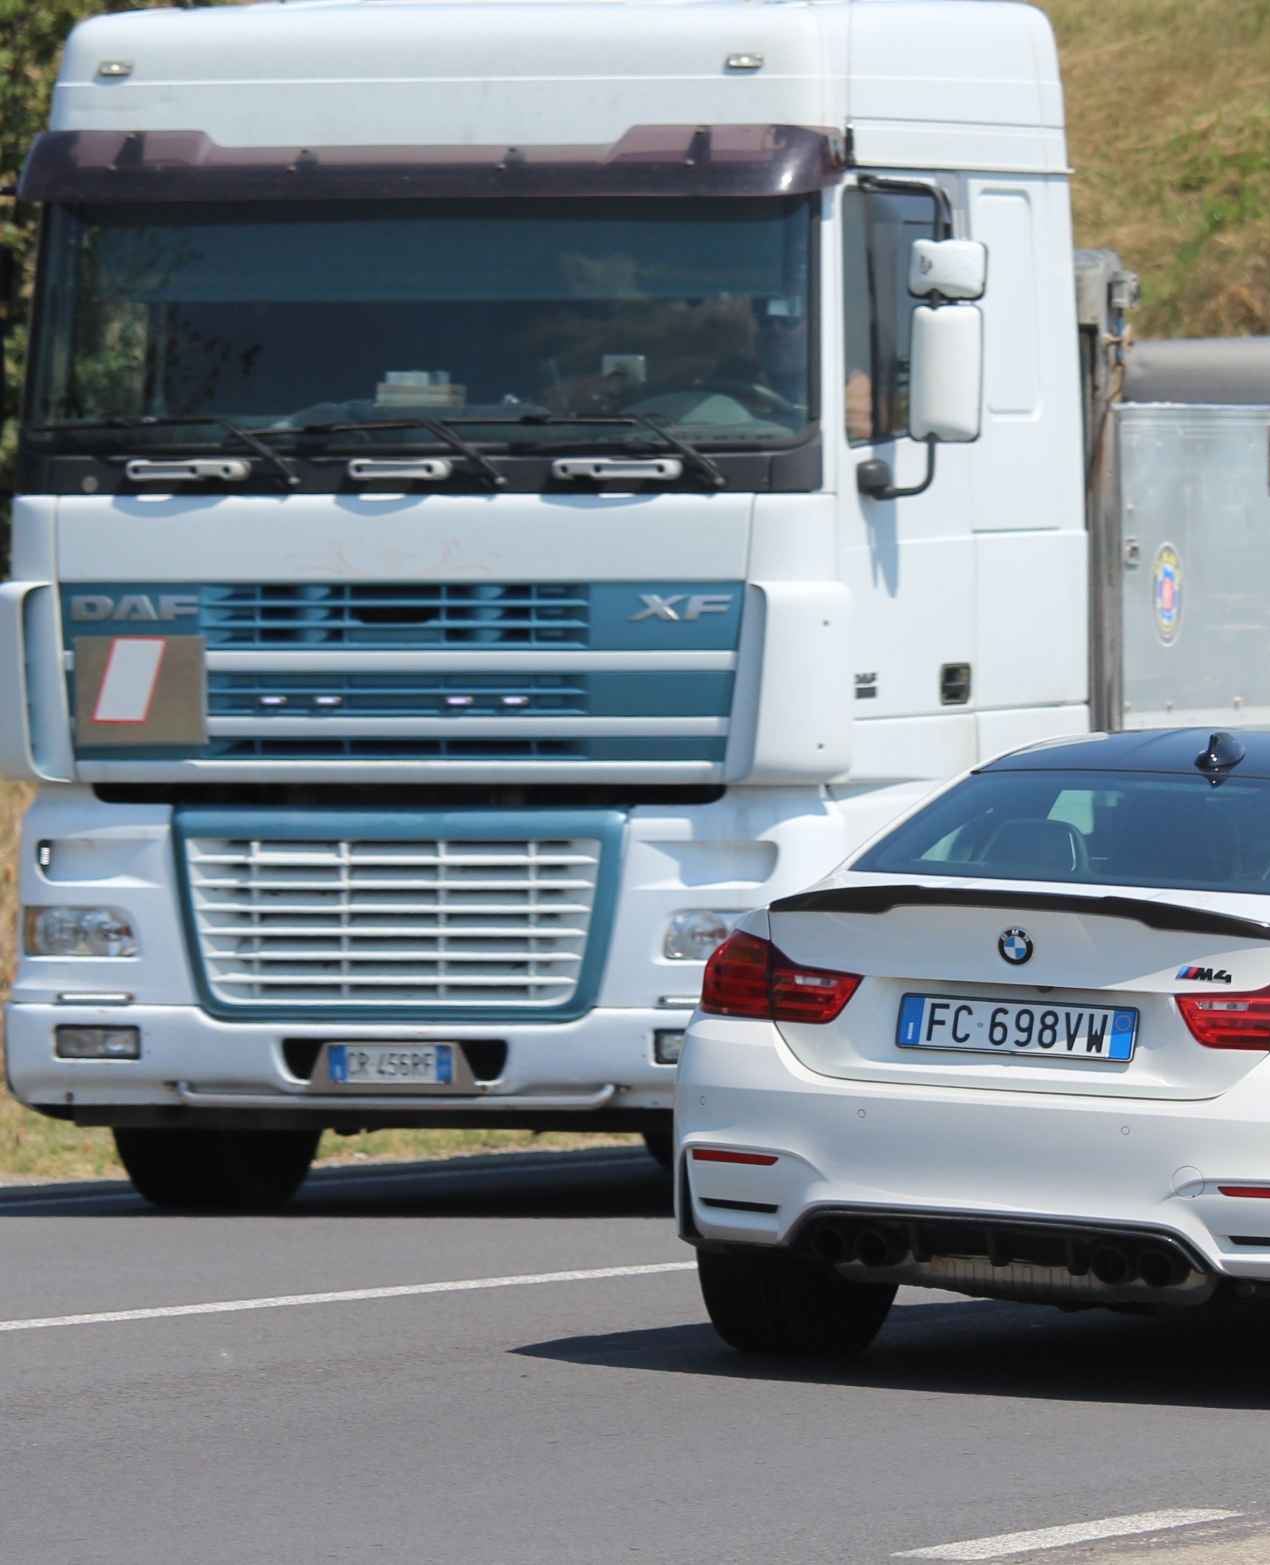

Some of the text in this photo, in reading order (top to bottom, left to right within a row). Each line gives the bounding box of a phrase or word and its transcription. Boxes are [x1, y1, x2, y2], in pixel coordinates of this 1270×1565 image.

[71, 594, 198, 621] DAF
[629, 593, 734, 621] XF
[1193, 966, 1232, 984] M4
[926, 1003, 973, 1043] FC
[988, 1007, 1109, 1053] 698VW
